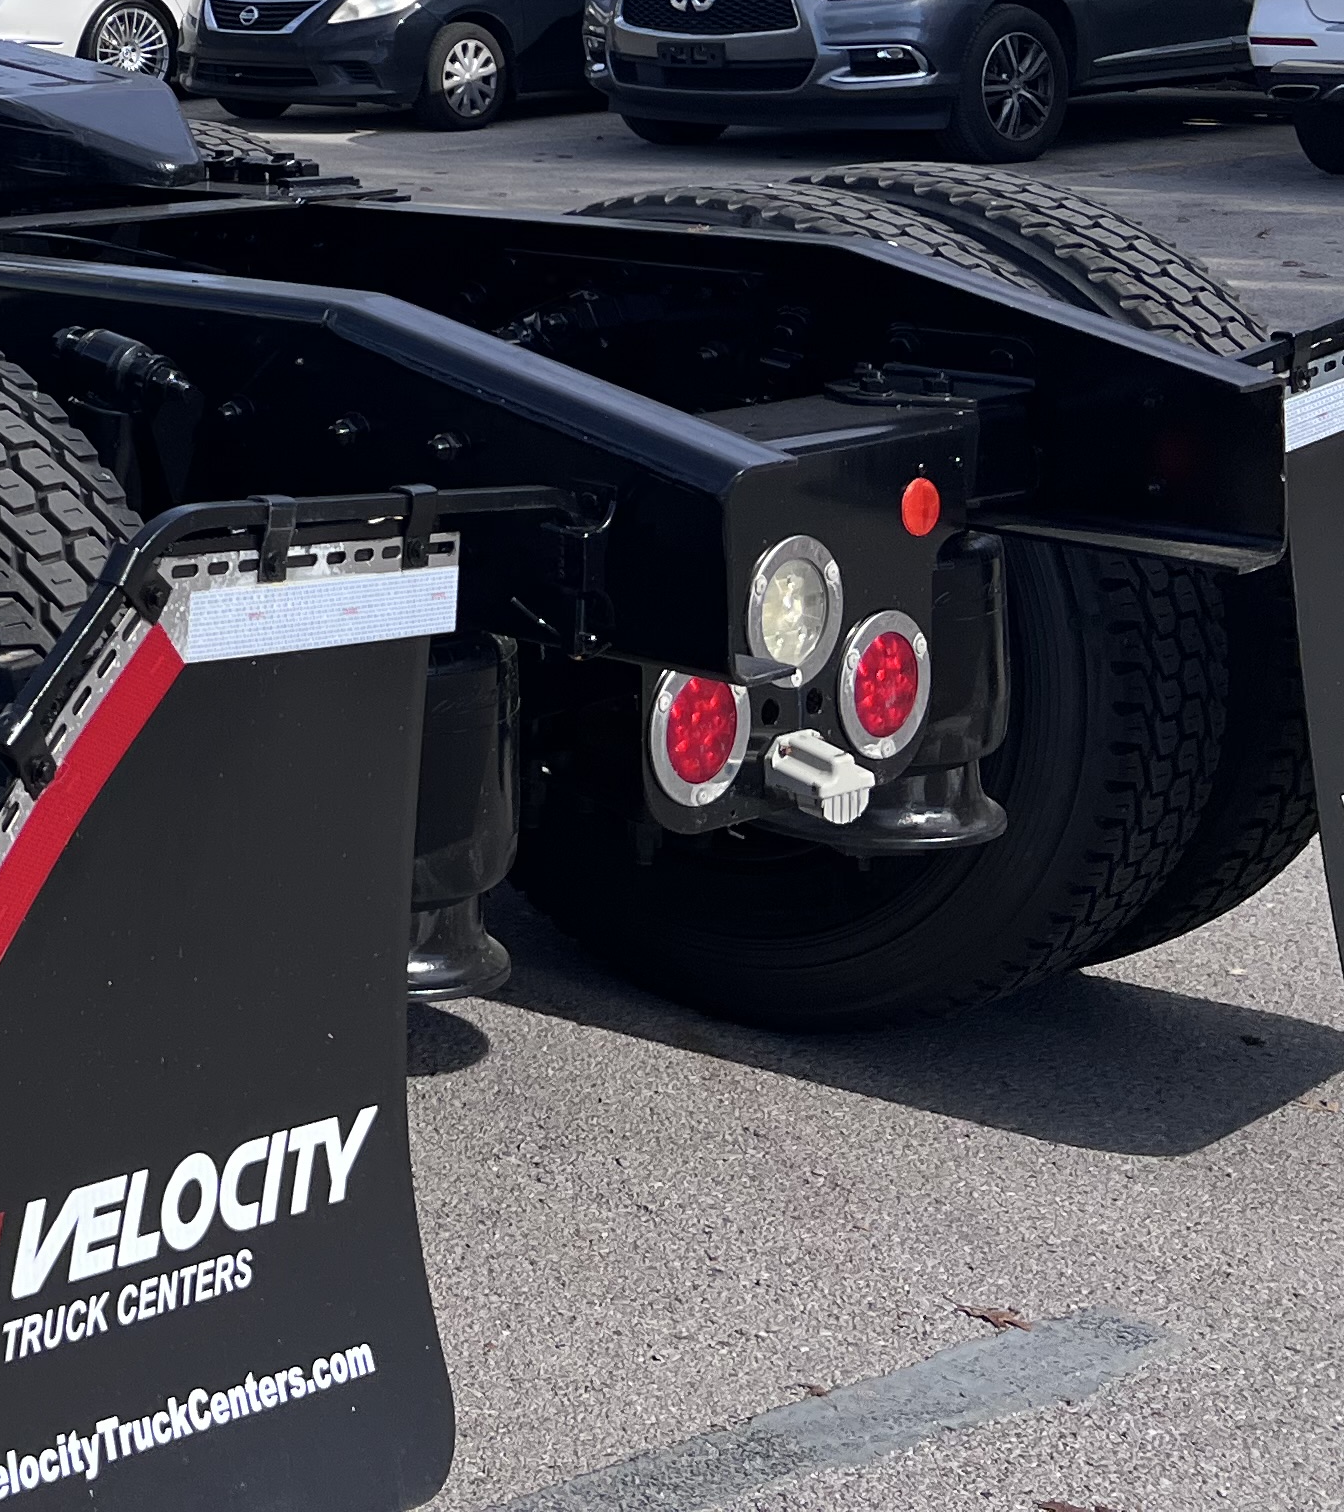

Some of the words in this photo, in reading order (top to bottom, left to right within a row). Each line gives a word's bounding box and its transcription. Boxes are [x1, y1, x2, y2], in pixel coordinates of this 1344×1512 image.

[12, 1105, 378, 1299] VELOCITY
[3, 1292, 109, 1362] TRUCK
[118, 1249, 253, 1326] CENTERS
